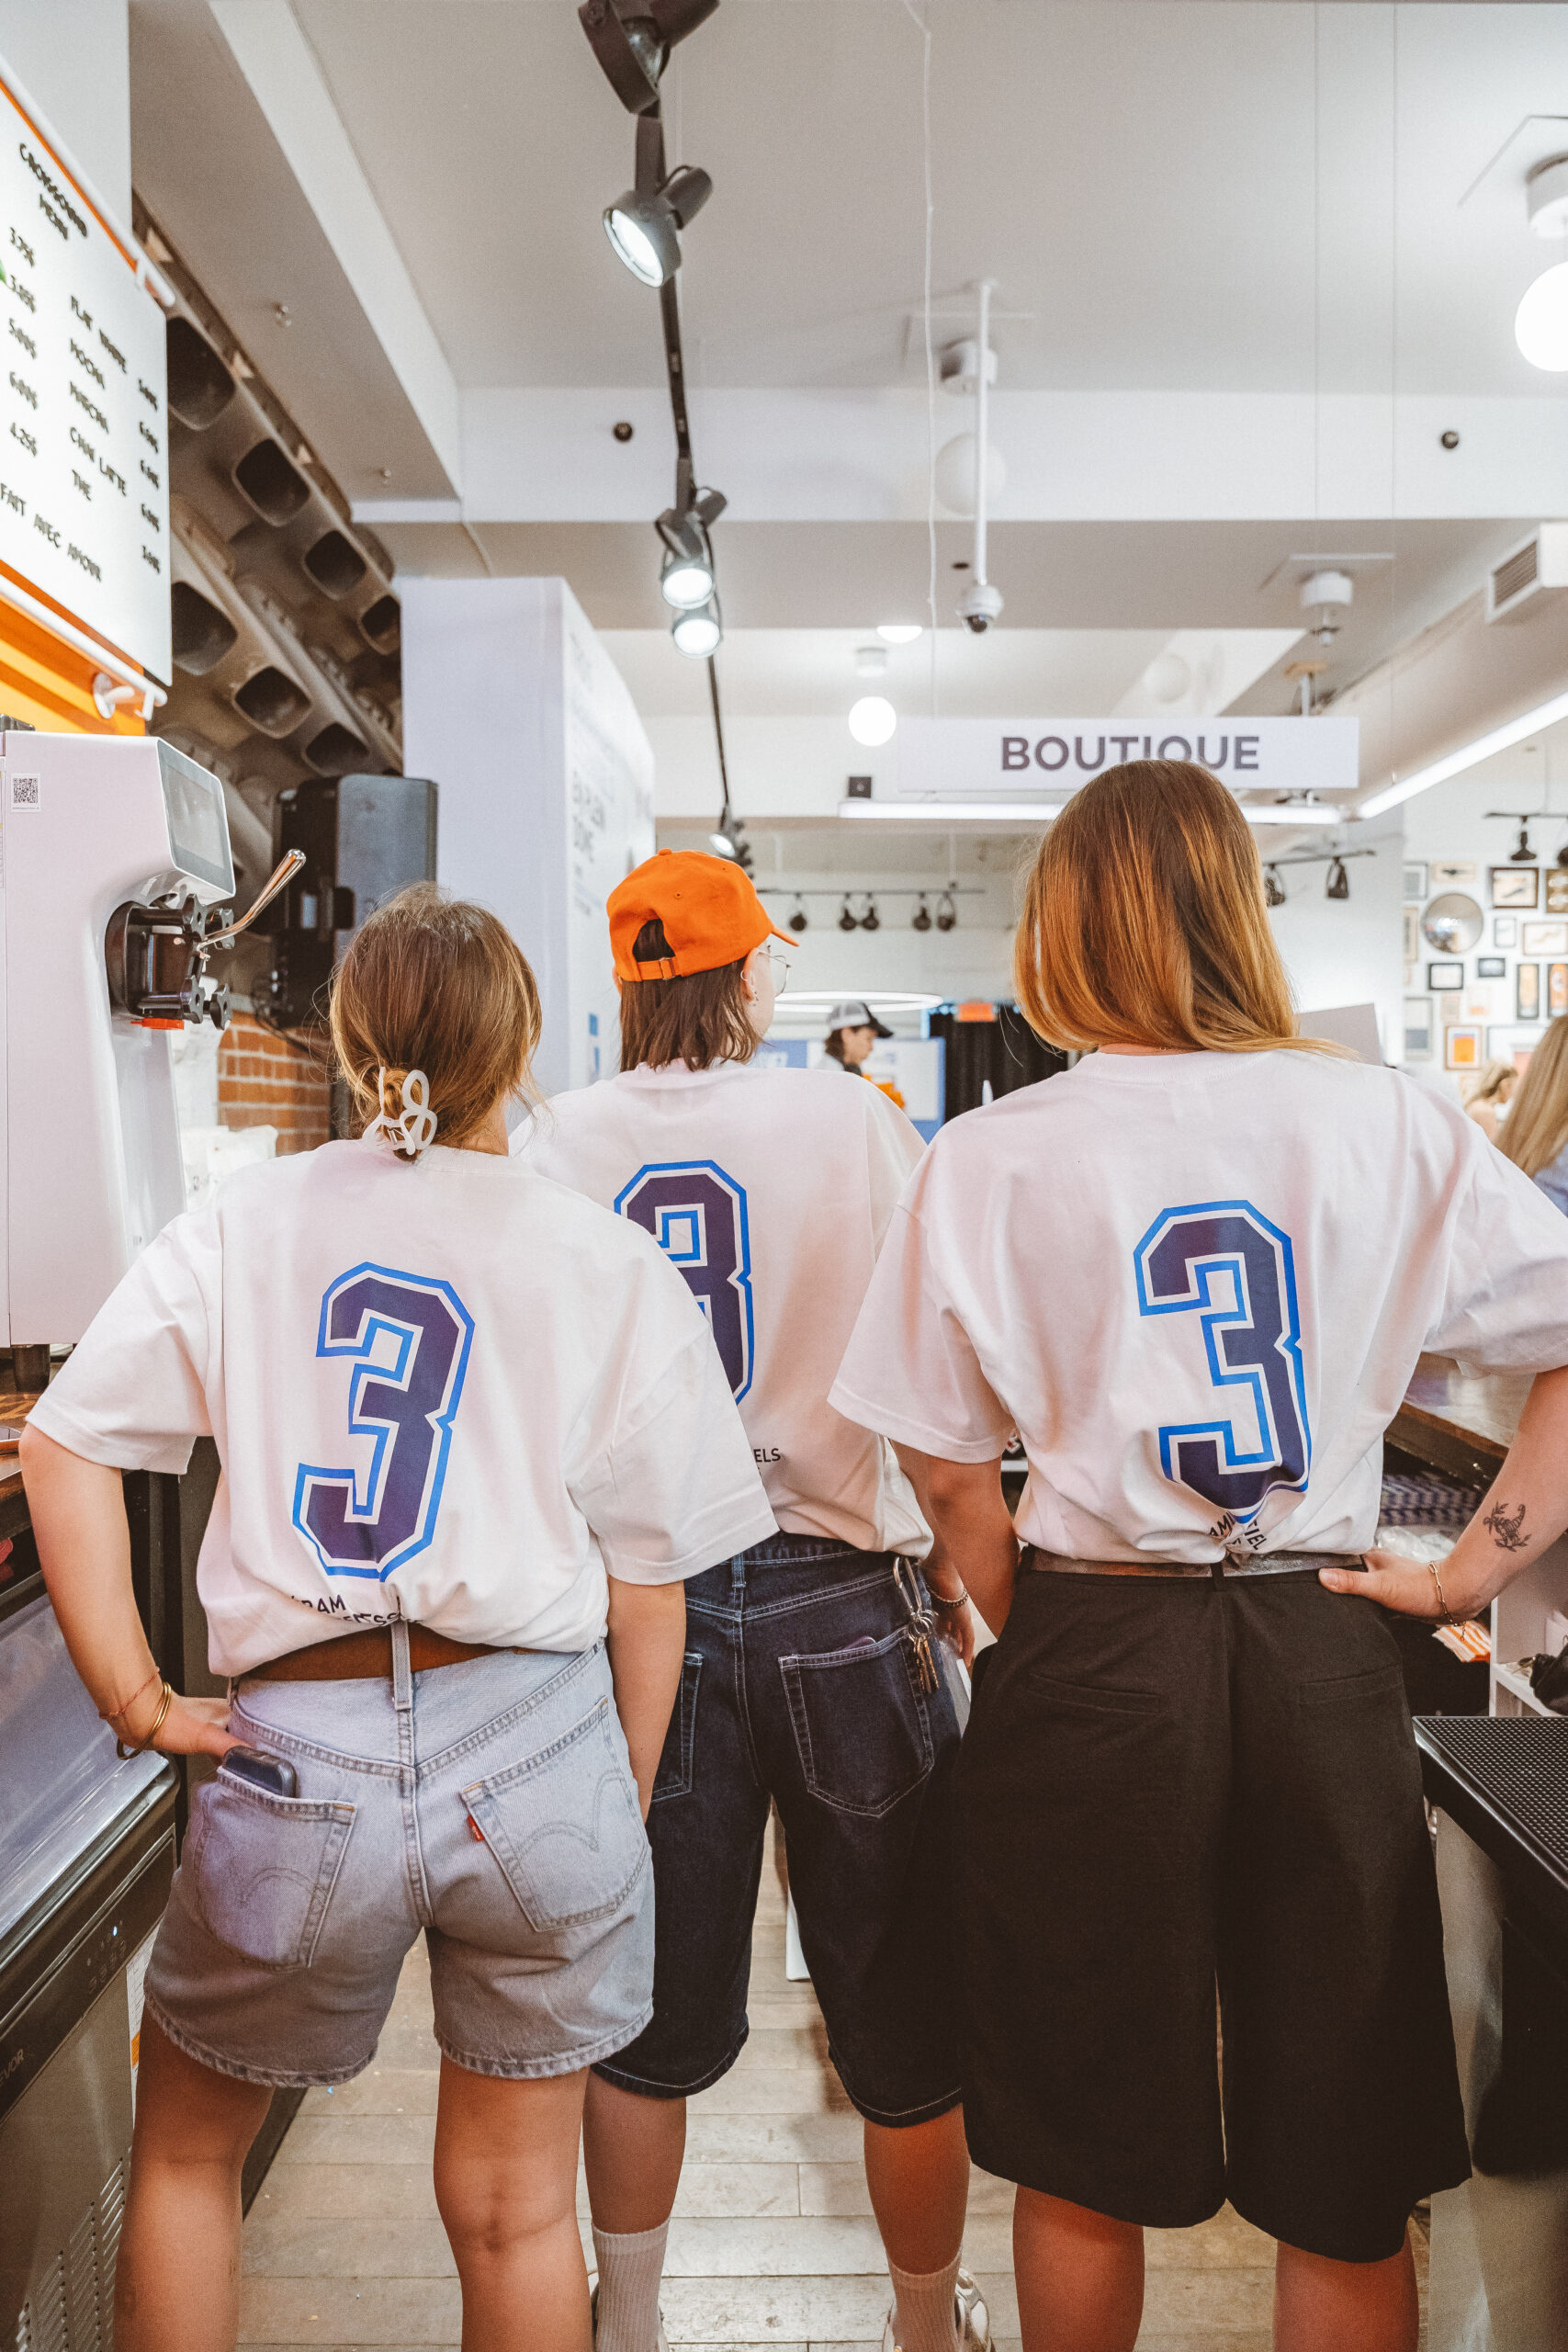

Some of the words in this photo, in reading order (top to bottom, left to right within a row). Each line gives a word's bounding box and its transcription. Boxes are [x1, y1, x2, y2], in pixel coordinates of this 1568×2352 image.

[70, 295, 93, 331] FLAT
[70, 338, 105, 390] MOCHA
[98, 457, 127, 497] LATTE
[0, 482, 26, 516] FAIT
[34, 514, 61, 548] AVEC
[67, 543, 102, 582] AMOUR
[1001, 735, 1259, 771] BOUTIQUE
[1134, 1200, 1312, 1524] 3
[293, 1261, 476, 1582] 3
